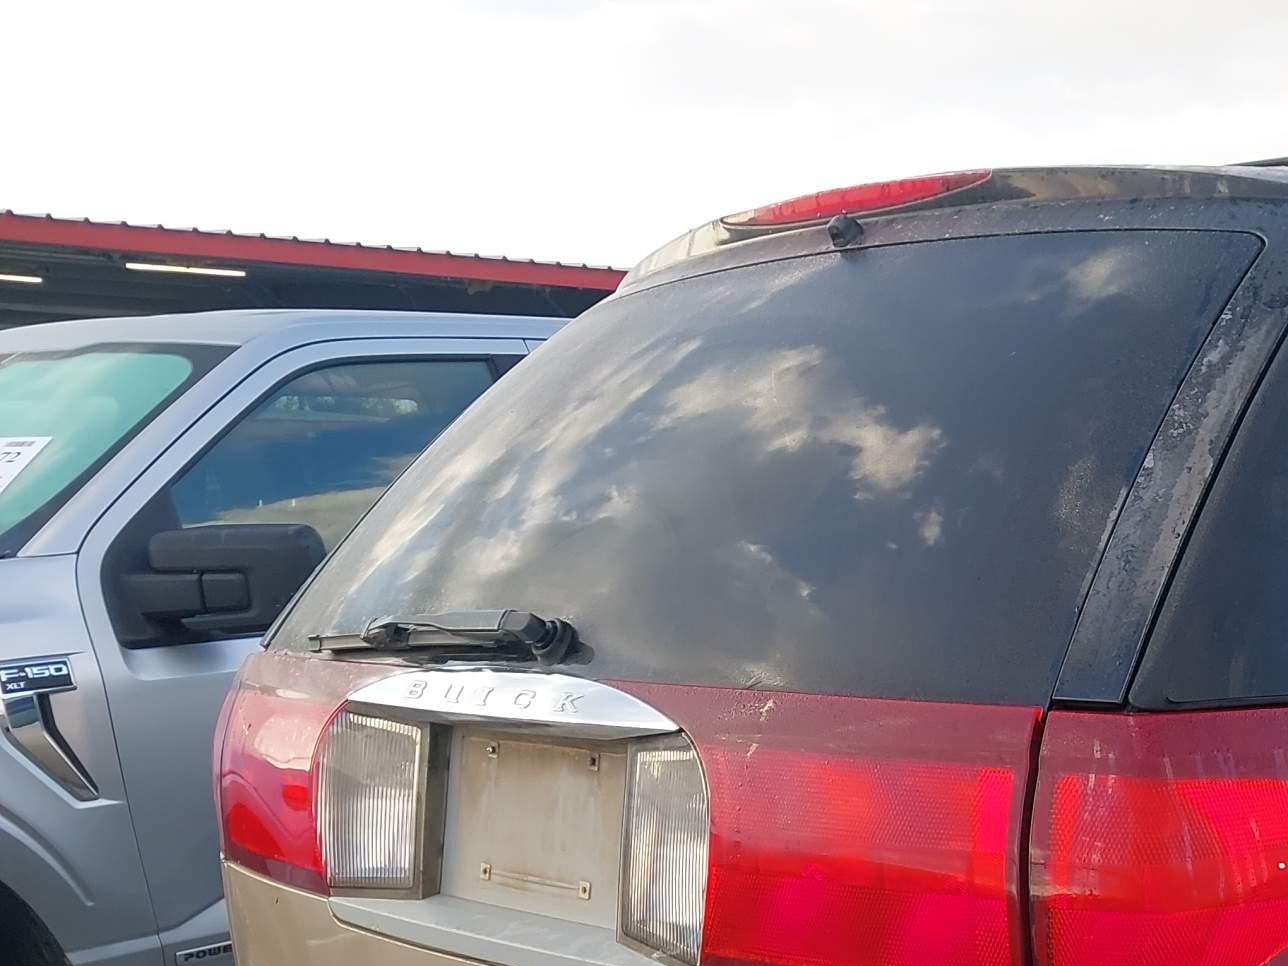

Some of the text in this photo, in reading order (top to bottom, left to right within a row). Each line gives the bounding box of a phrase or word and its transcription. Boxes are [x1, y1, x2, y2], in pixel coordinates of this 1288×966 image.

[0, 663, 69, 682] F-150
[6, 681, 26, 690] XLT
[405, 679, 584, 714] BUICK
